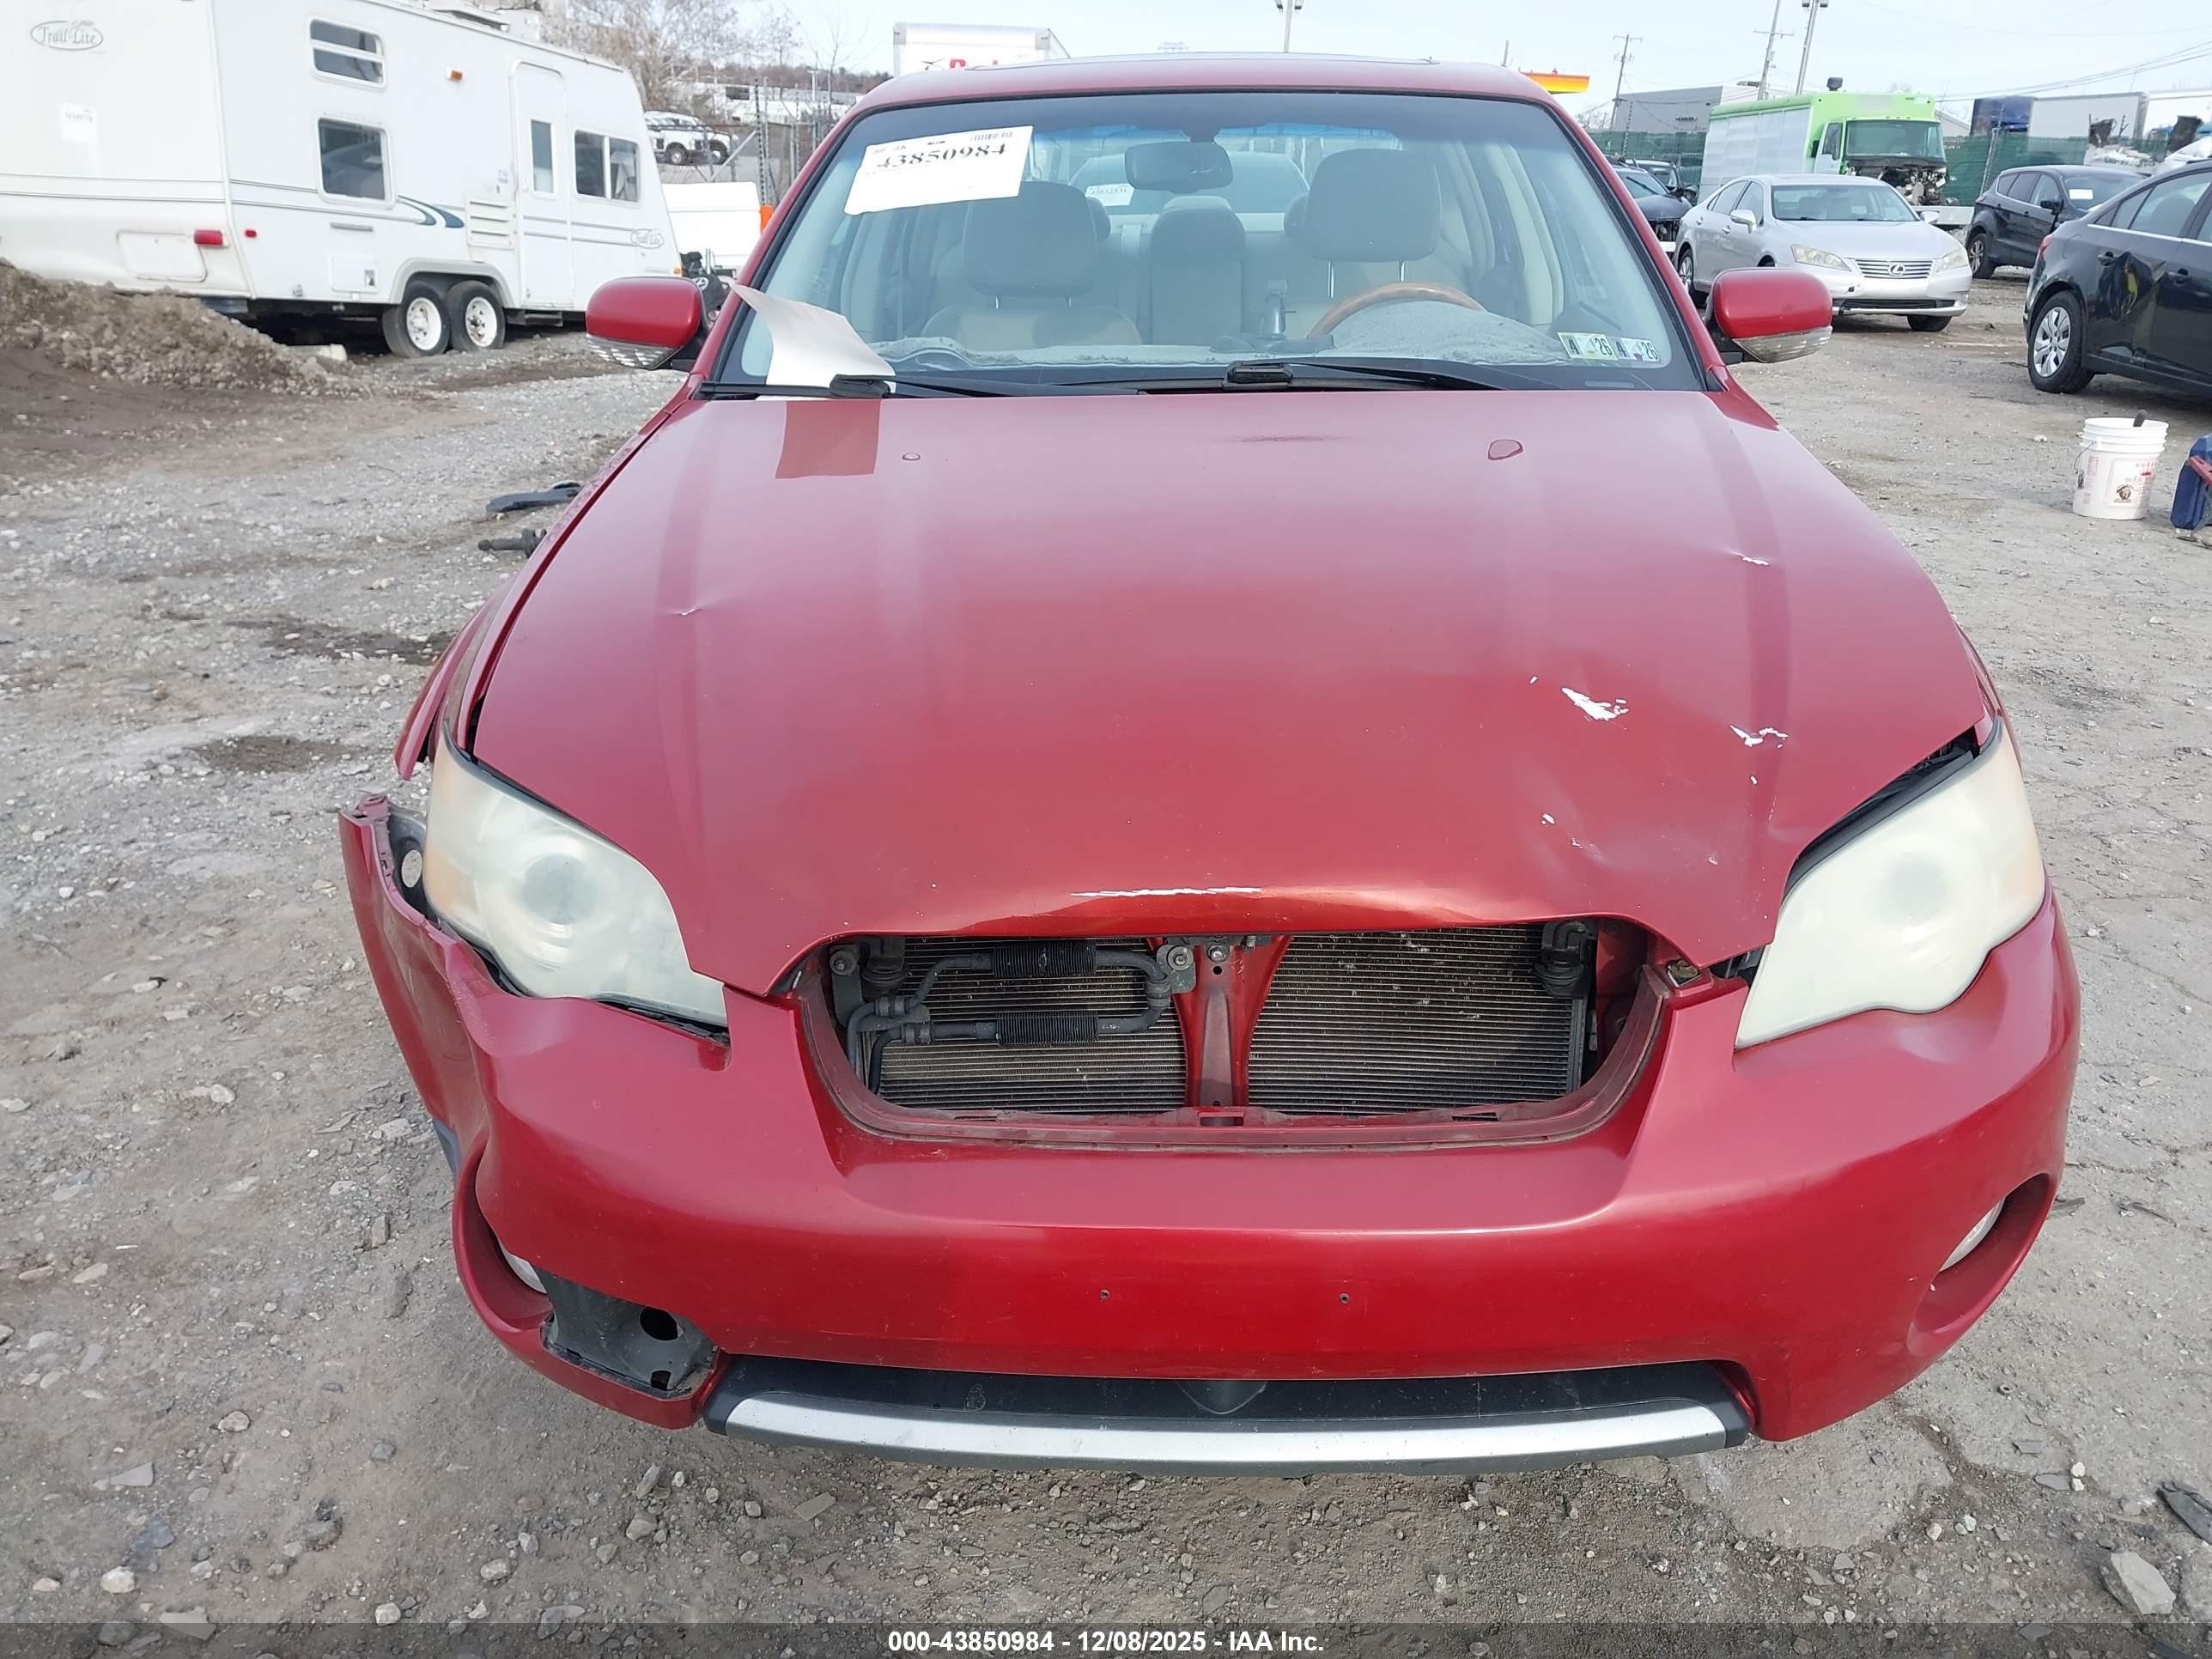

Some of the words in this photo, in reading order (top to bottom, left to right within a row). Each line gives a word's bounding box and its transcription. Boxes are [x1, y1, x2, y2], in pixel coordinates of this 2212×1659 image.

[37, 27, 69, 44] Trail
[72, 26, 97, 44] Lite
[876, 143, 1006, 168] 43850984
[1594, 337, 1613, 356] 26
[1640, 341, 1659, 361] 26
